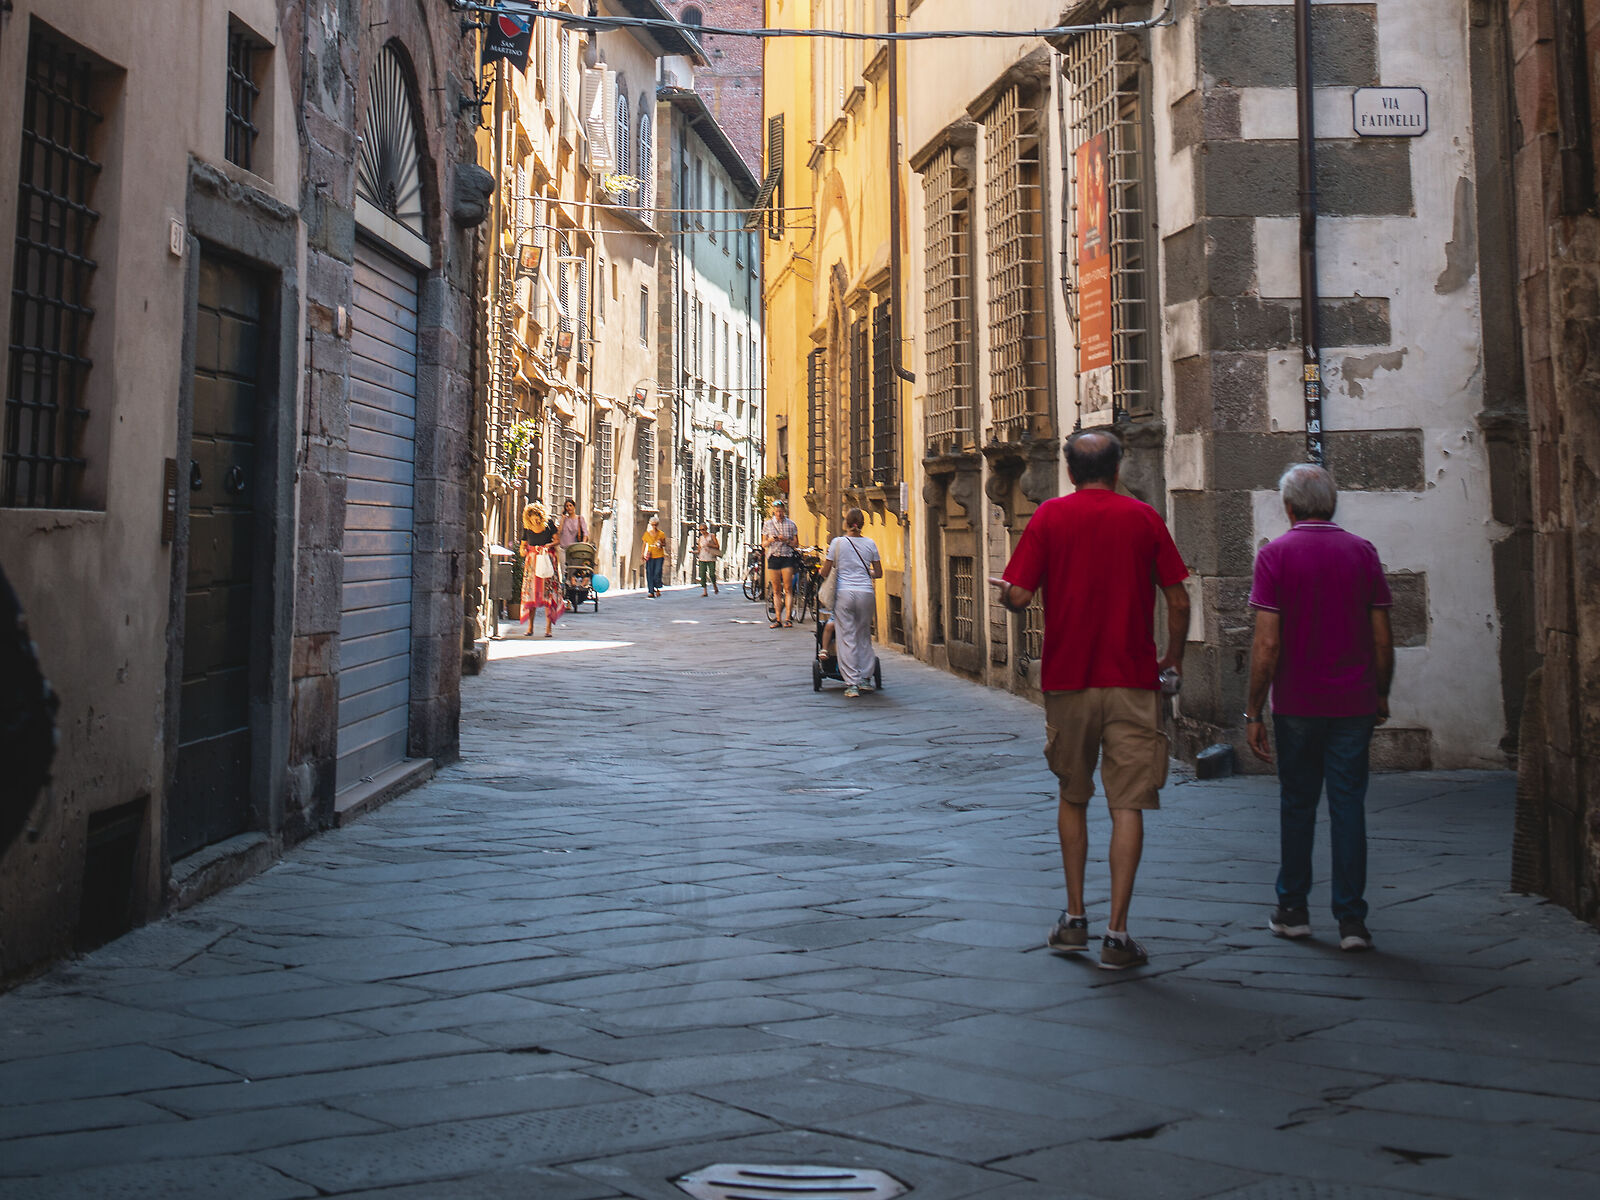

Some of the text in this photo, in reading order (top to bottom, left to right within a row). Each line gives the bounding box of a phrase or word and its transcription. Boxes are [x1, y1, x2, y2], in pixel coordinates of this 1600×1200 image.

[490, 44, 523, 56] MARTINO
[499, 40, 515, 48] SAN
[1382, 97, 1399, 110] VIA
[1361, 114, 1421, 127] FATINELLI
